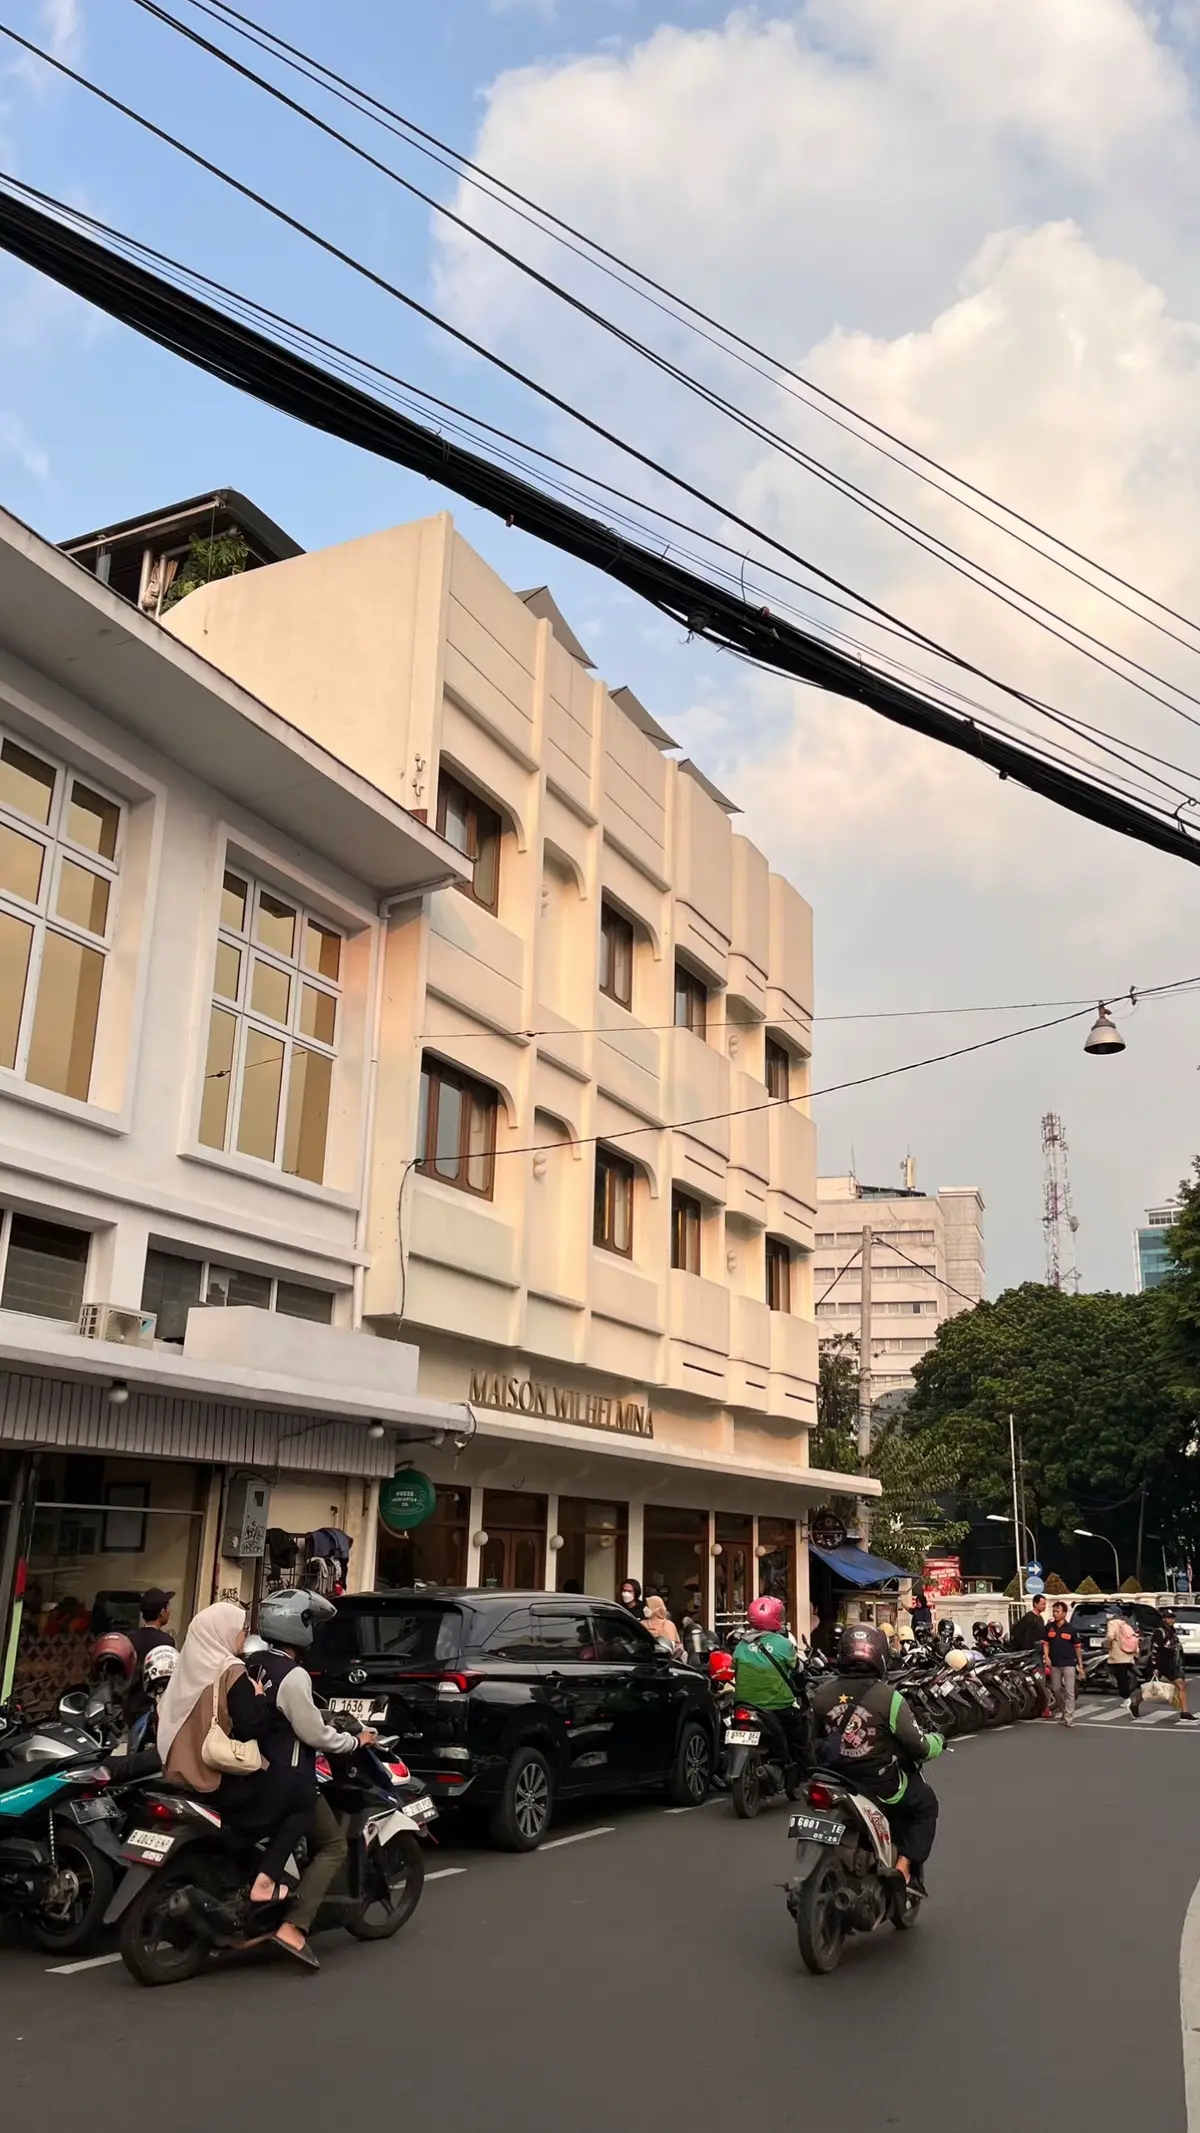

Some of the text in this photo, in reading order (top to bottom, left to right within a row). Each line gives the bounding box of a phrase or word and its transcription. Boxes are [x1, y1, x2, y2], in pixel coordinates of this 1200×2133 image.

[469, 1367, 653, 1435] MAISON WILHELMINA
[342, 1699, 363, 1713] 1636
[797, 1817, 820, 1830] 6881
